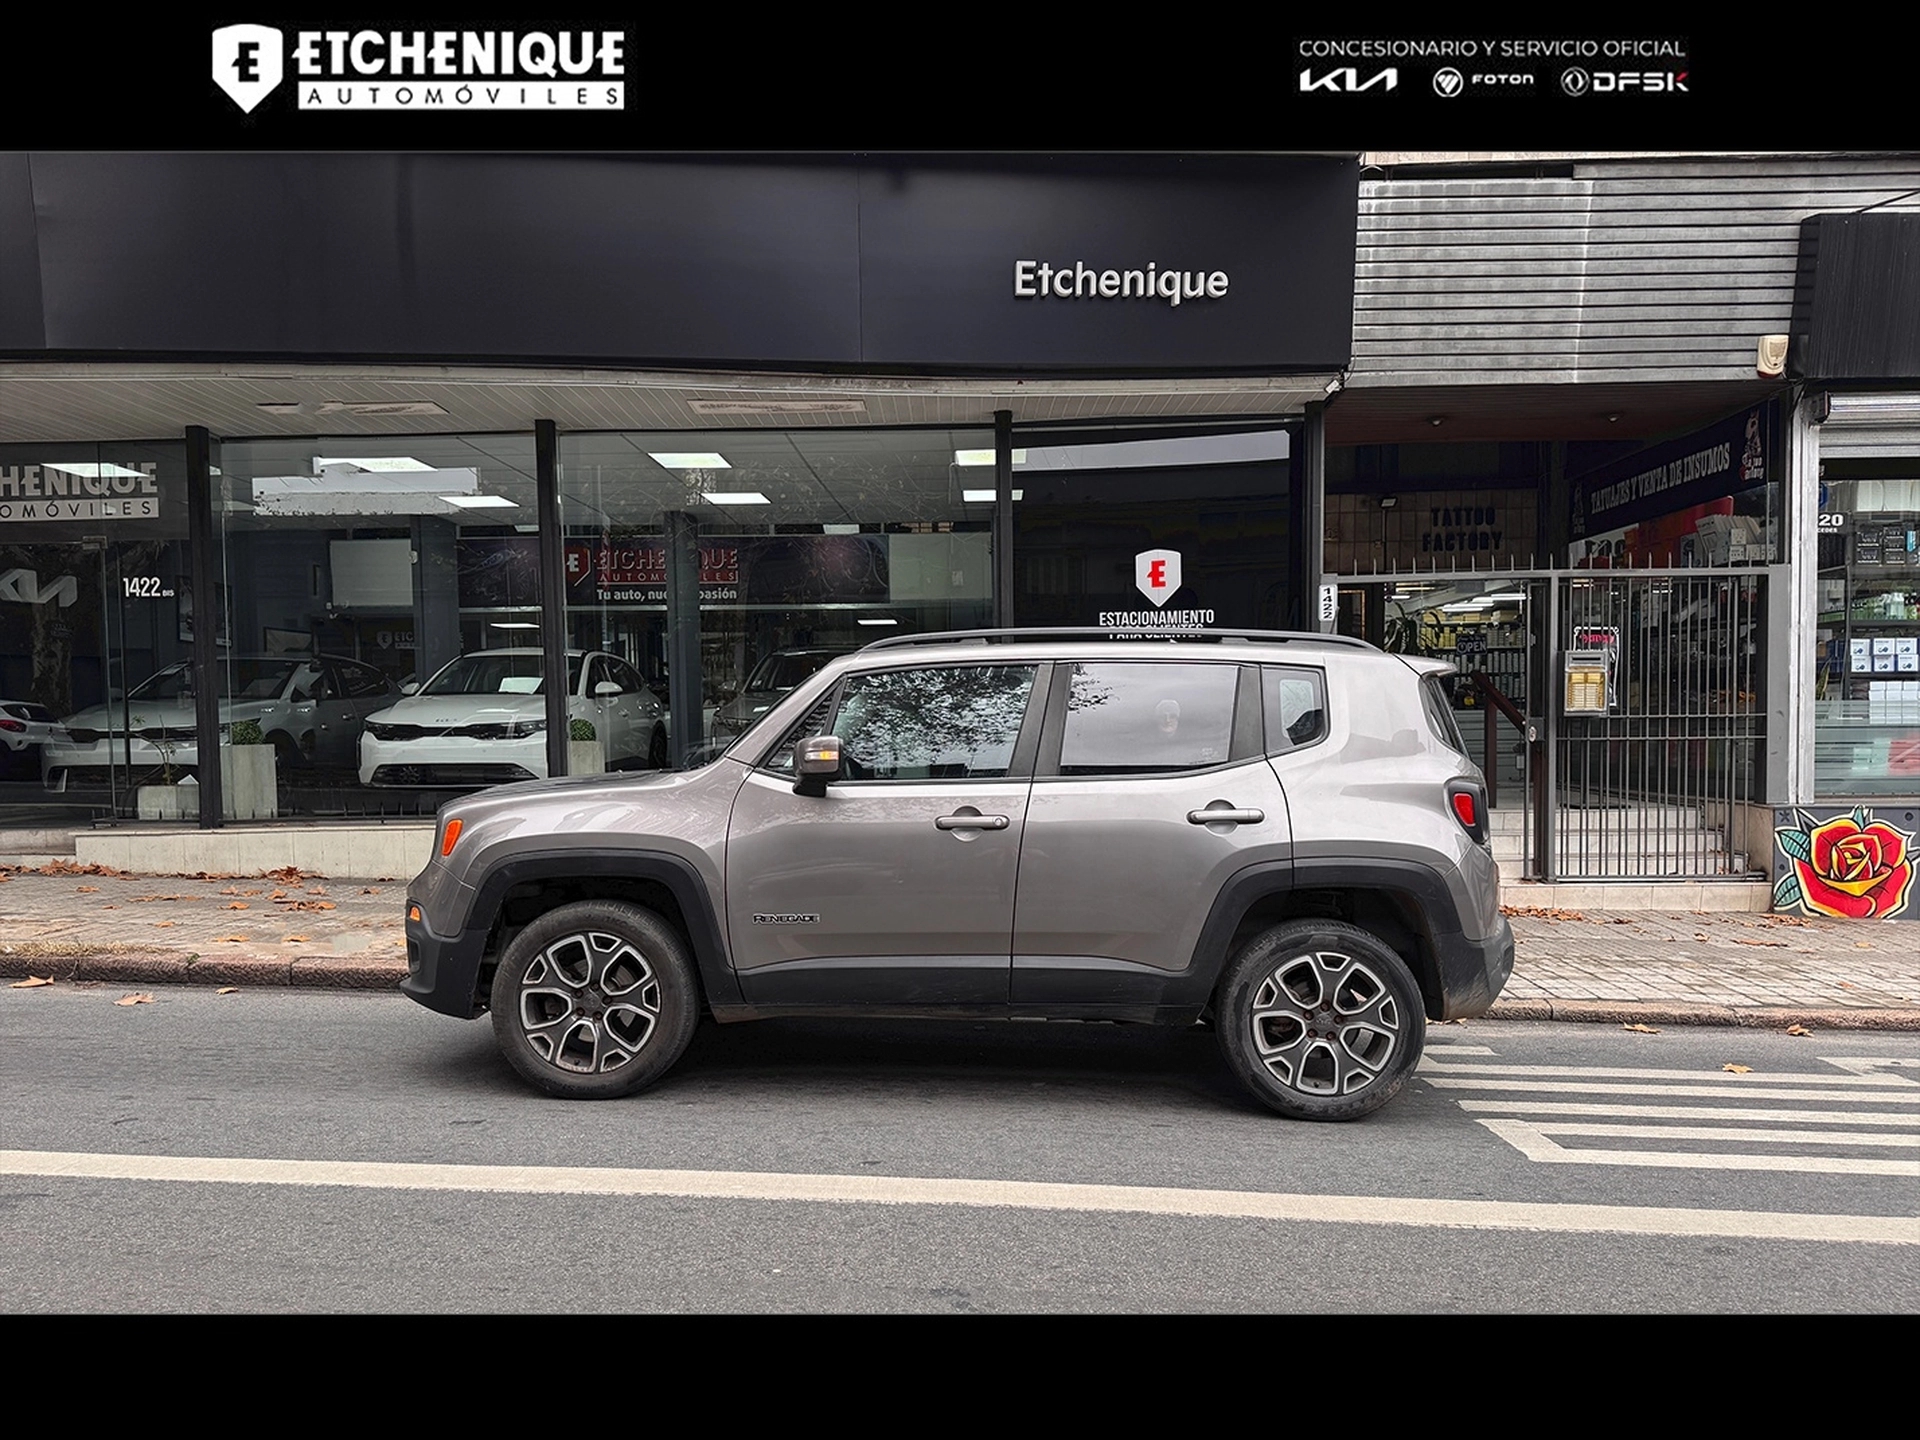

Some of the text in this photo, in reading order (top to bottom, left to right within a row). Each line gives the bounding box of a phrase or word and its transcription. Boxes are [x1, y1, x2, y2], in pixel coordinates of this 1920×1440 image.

[1014, 259, 1230, 307] Etchenique
[1591, 482, 1631, 514] TATUAJES
[1637, 465, 1668, 497] VENTA
[1669, 459, 1682, 487] DE
[1683, 442, 1731, 482] INSUMOS
[1431, 506, 1496, 527] TATTOO
[1422, 532, 1502, 552] FACTORY
[594, 549, 738, 569] ETCHEQUE
[122, 576, 161, 597] 1422
[600, 573, 734, 582] AUTOMLES
[597, 590, 611, 600] Tu
[614, 590, 645, 601] auto,
[1322, 587, 1333, 619] 1422
[1099, 609, 1215, 626] ESTACIONAMIENTO
[1456, 641, 1487, 653] OPEN
[753, 913, 820, 925] RENEGADE
